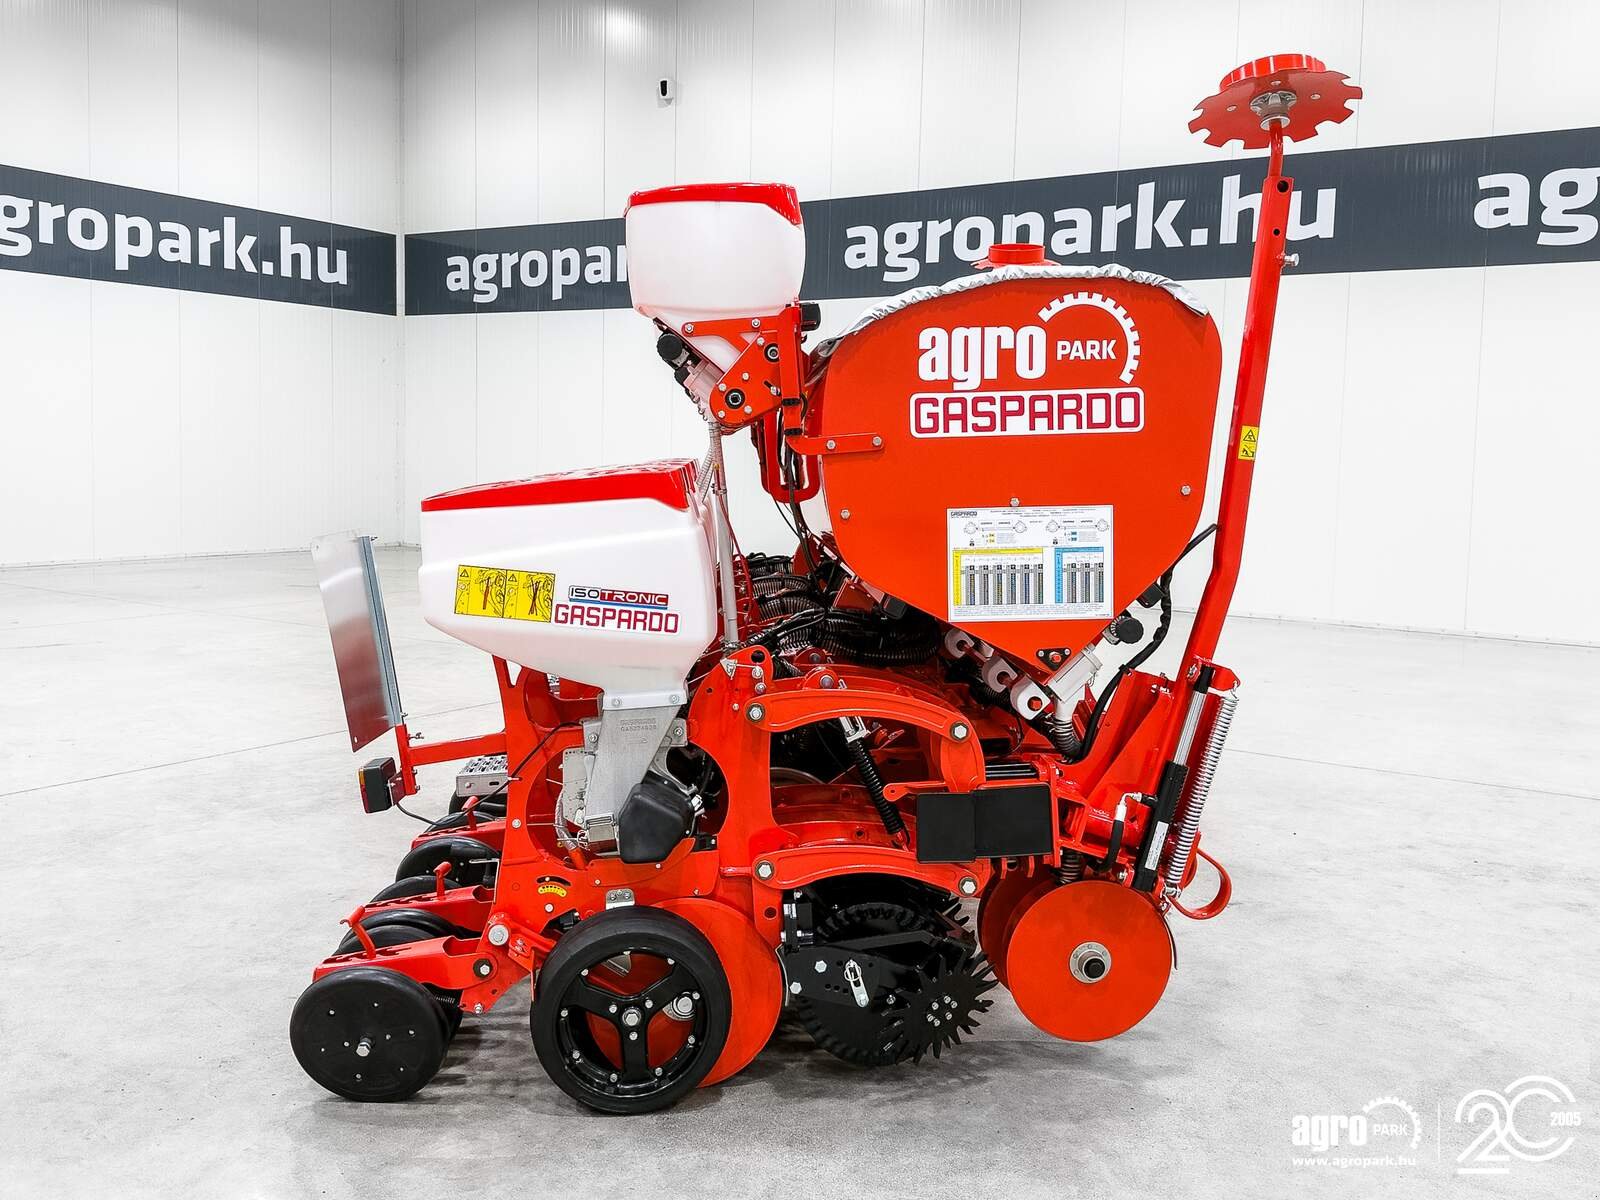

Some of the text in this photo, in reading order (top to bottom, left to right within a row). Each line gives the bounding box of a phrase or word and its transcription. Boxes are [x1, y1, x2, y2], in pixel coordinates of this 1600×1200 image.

[918, 325, 1117, 390] agro PARK
[914, 391, 1141, 434] GASPARDO
[570, 587, 668, 606] ISOTRONIC
[554, 603, 679, 634] GASPARDO
